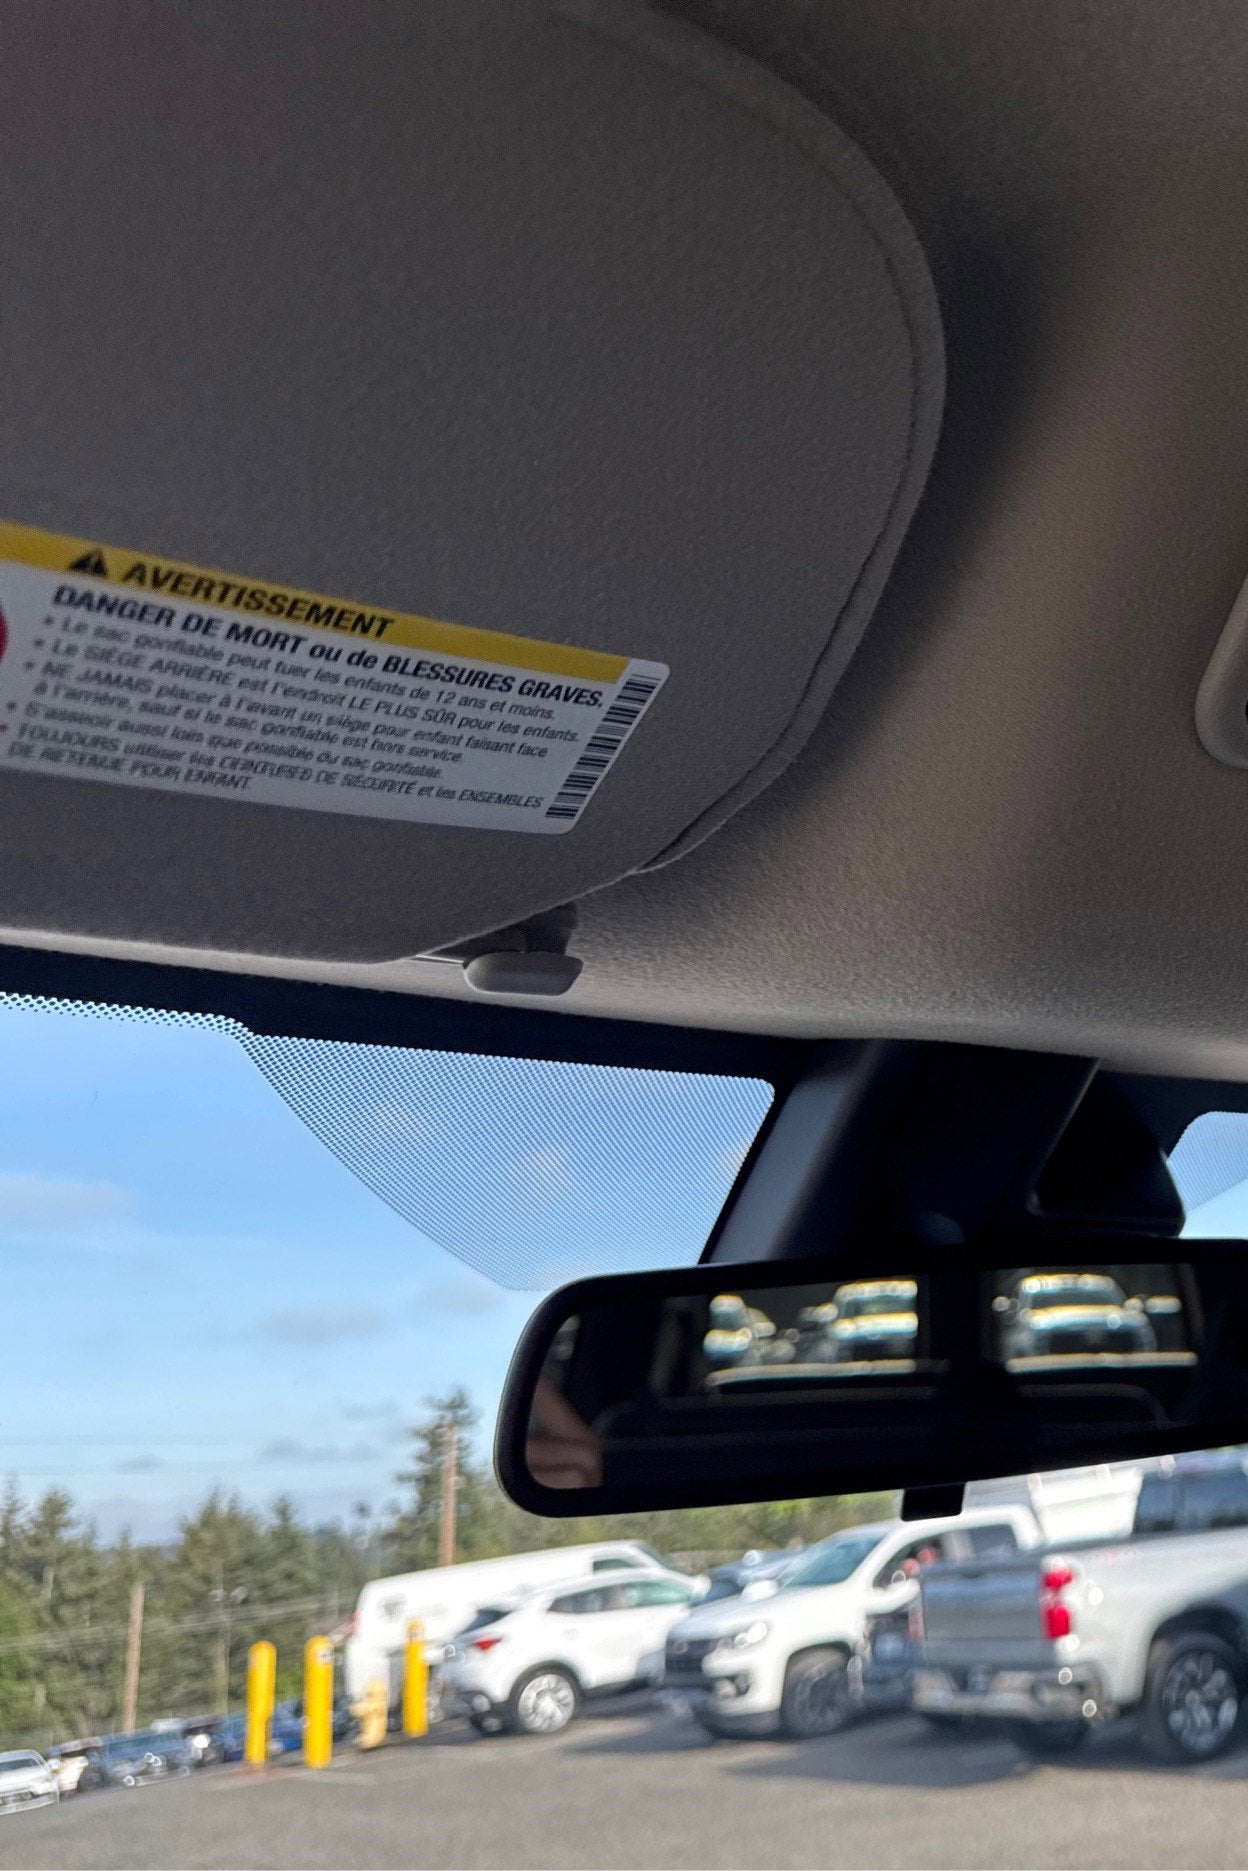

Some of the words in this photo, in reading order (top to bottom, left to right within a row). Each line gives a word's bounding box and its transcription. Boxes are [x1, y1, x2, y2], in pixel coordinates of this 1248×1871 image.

[121, 562, 394, 637] AVERTISSEMENT
[53, 584, 177, 628] DANGER
[181, 611, 223, 637] DE
[225, 622, 309, 654] MORT
[309, 644, 343, 662] ou
[347, 649, 378, 668] de
[382, 655, 515, 693] BLESSURES
[518, 679, 603, 707] GRAVES.
[62, 615, 88, 634] Le
[227, 651, 271, 672] peut
[274, 660, 309, 678] tuer
[314, 668, 340, 684] les
[344, 675, 406, 697] enfants
[409, 686, 430, 700] de
[437, 690, 456, 704] 12
[458, 696, 485, 710] ans
[490, 701, 505, 713] et
[508, 703, 555, 720] moins.
[76, 669, 153, 694] JAMAIS
[414, 728, 463, 746] enfant
[517, 743, 547, 758] face
[348, 696, 372, 711] LE
[374, 700, 419, 720] PLUS
[458, 716, 495, 731] pour
[497, 720, 520, 734] les
[522, 725, 580, 742] enfants.
